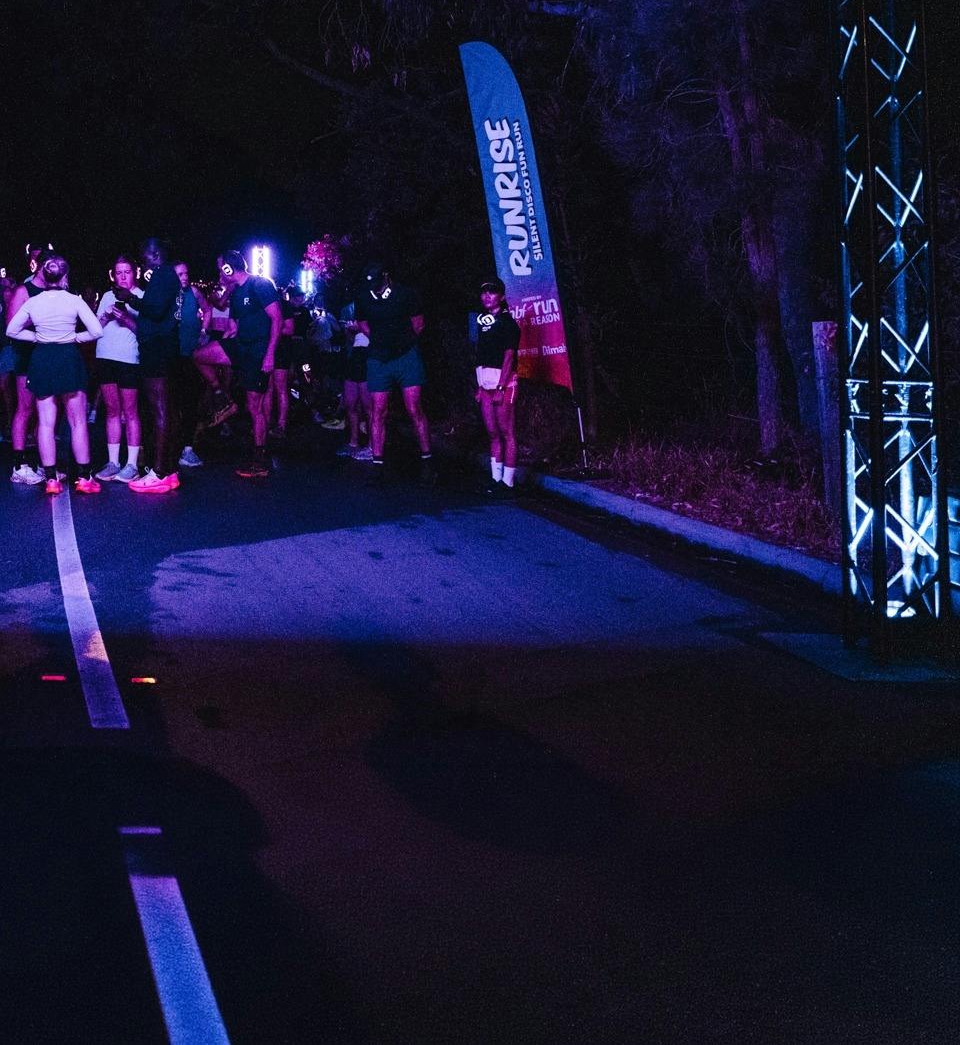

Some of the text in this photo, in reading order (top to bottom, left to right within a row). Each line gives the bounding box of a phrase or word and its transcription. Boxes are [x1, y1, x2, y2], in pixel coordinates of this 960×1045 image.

[484, 119, 532, 276] RUNRISE
[513, 121, 543, 261] SILENT DISCO FUN RUN
[530, 313, 560, 325] REASON
[533, 298, 559, 315] run
